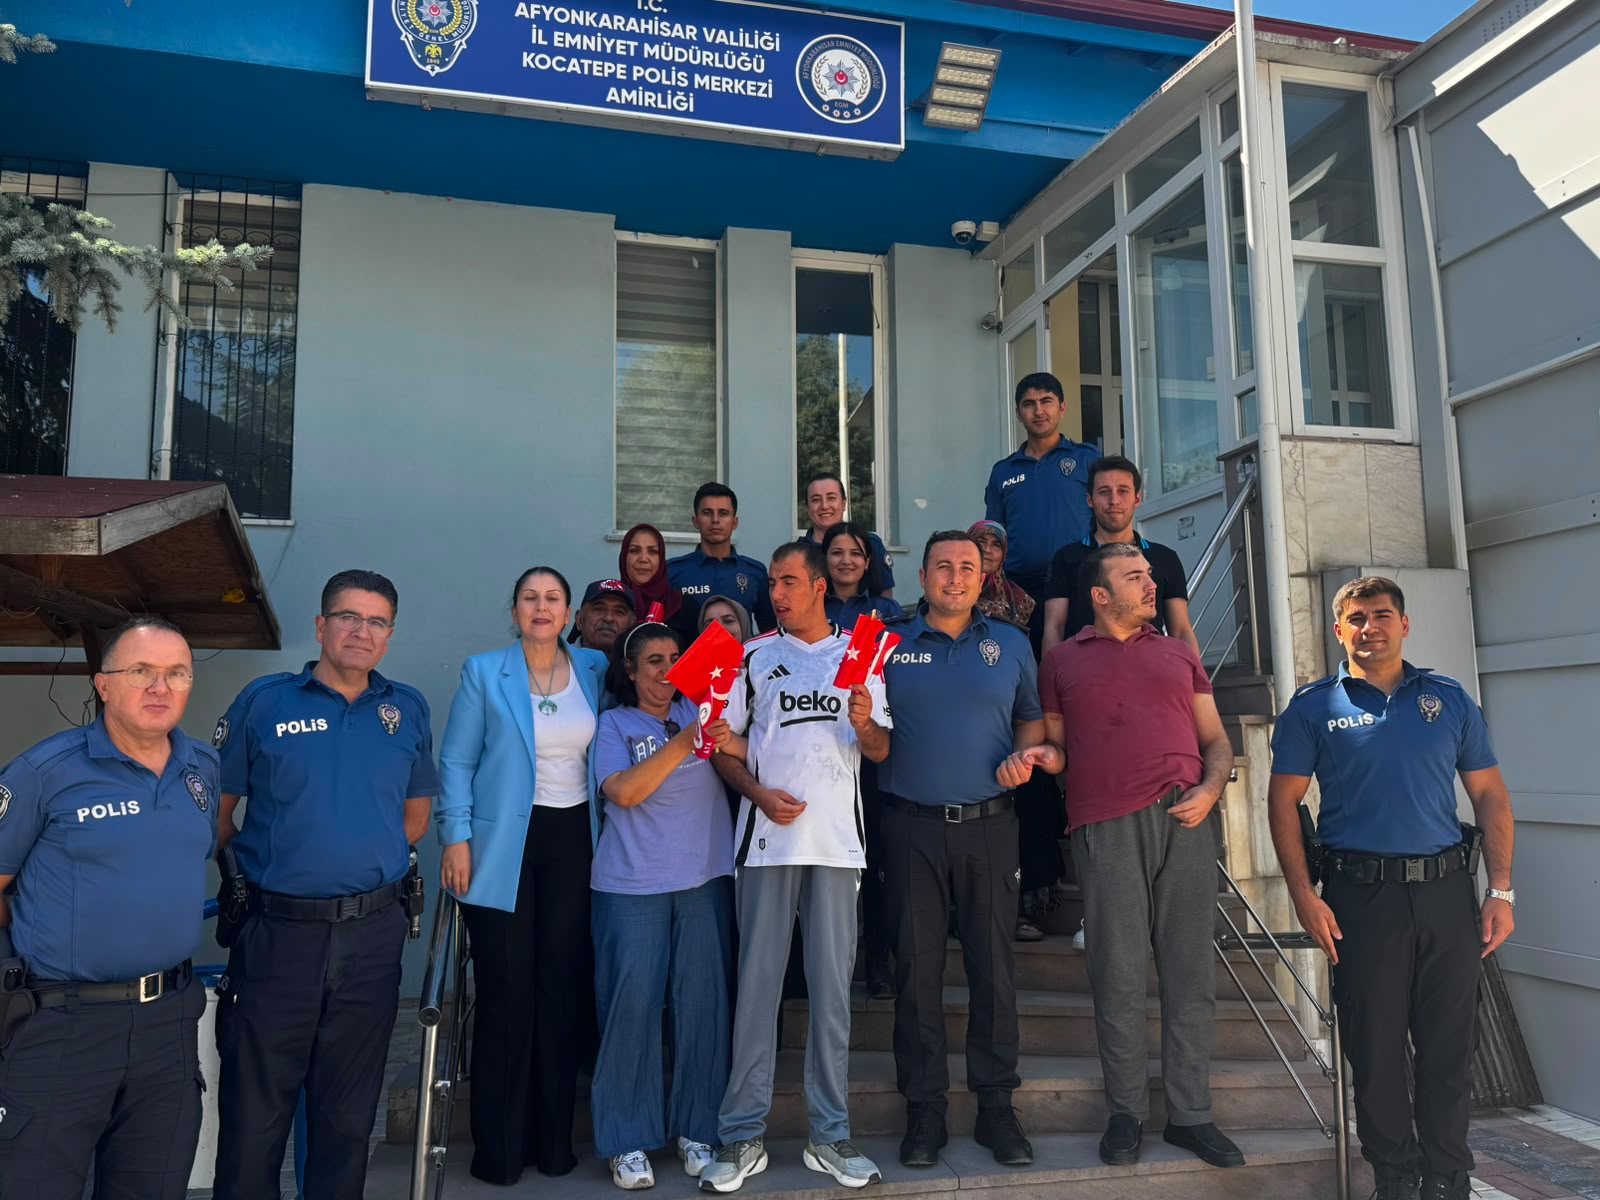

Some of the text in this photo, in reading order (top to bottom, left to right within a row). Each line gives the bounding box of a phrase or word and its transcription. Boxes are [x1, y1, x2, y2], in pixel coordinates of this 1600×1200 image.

[418, 32, 449, 41] GENEL
[514, 2, 780, 52] AFYONKARAHİSAR VALİLİĞİ
[531, 24, 765, 73] İL EMNİYET MÜDÜRLÜĞÜ
[835, 40, 862, 55] EMNİYET
[522, 51, 773, 98] KOCATEPE POLİS MERKEZİ
[605, 86, 694, 112] AMİRLİĞİ
[834, 101, 849, 109] EGM
[779, 690, 842, 714] beko
